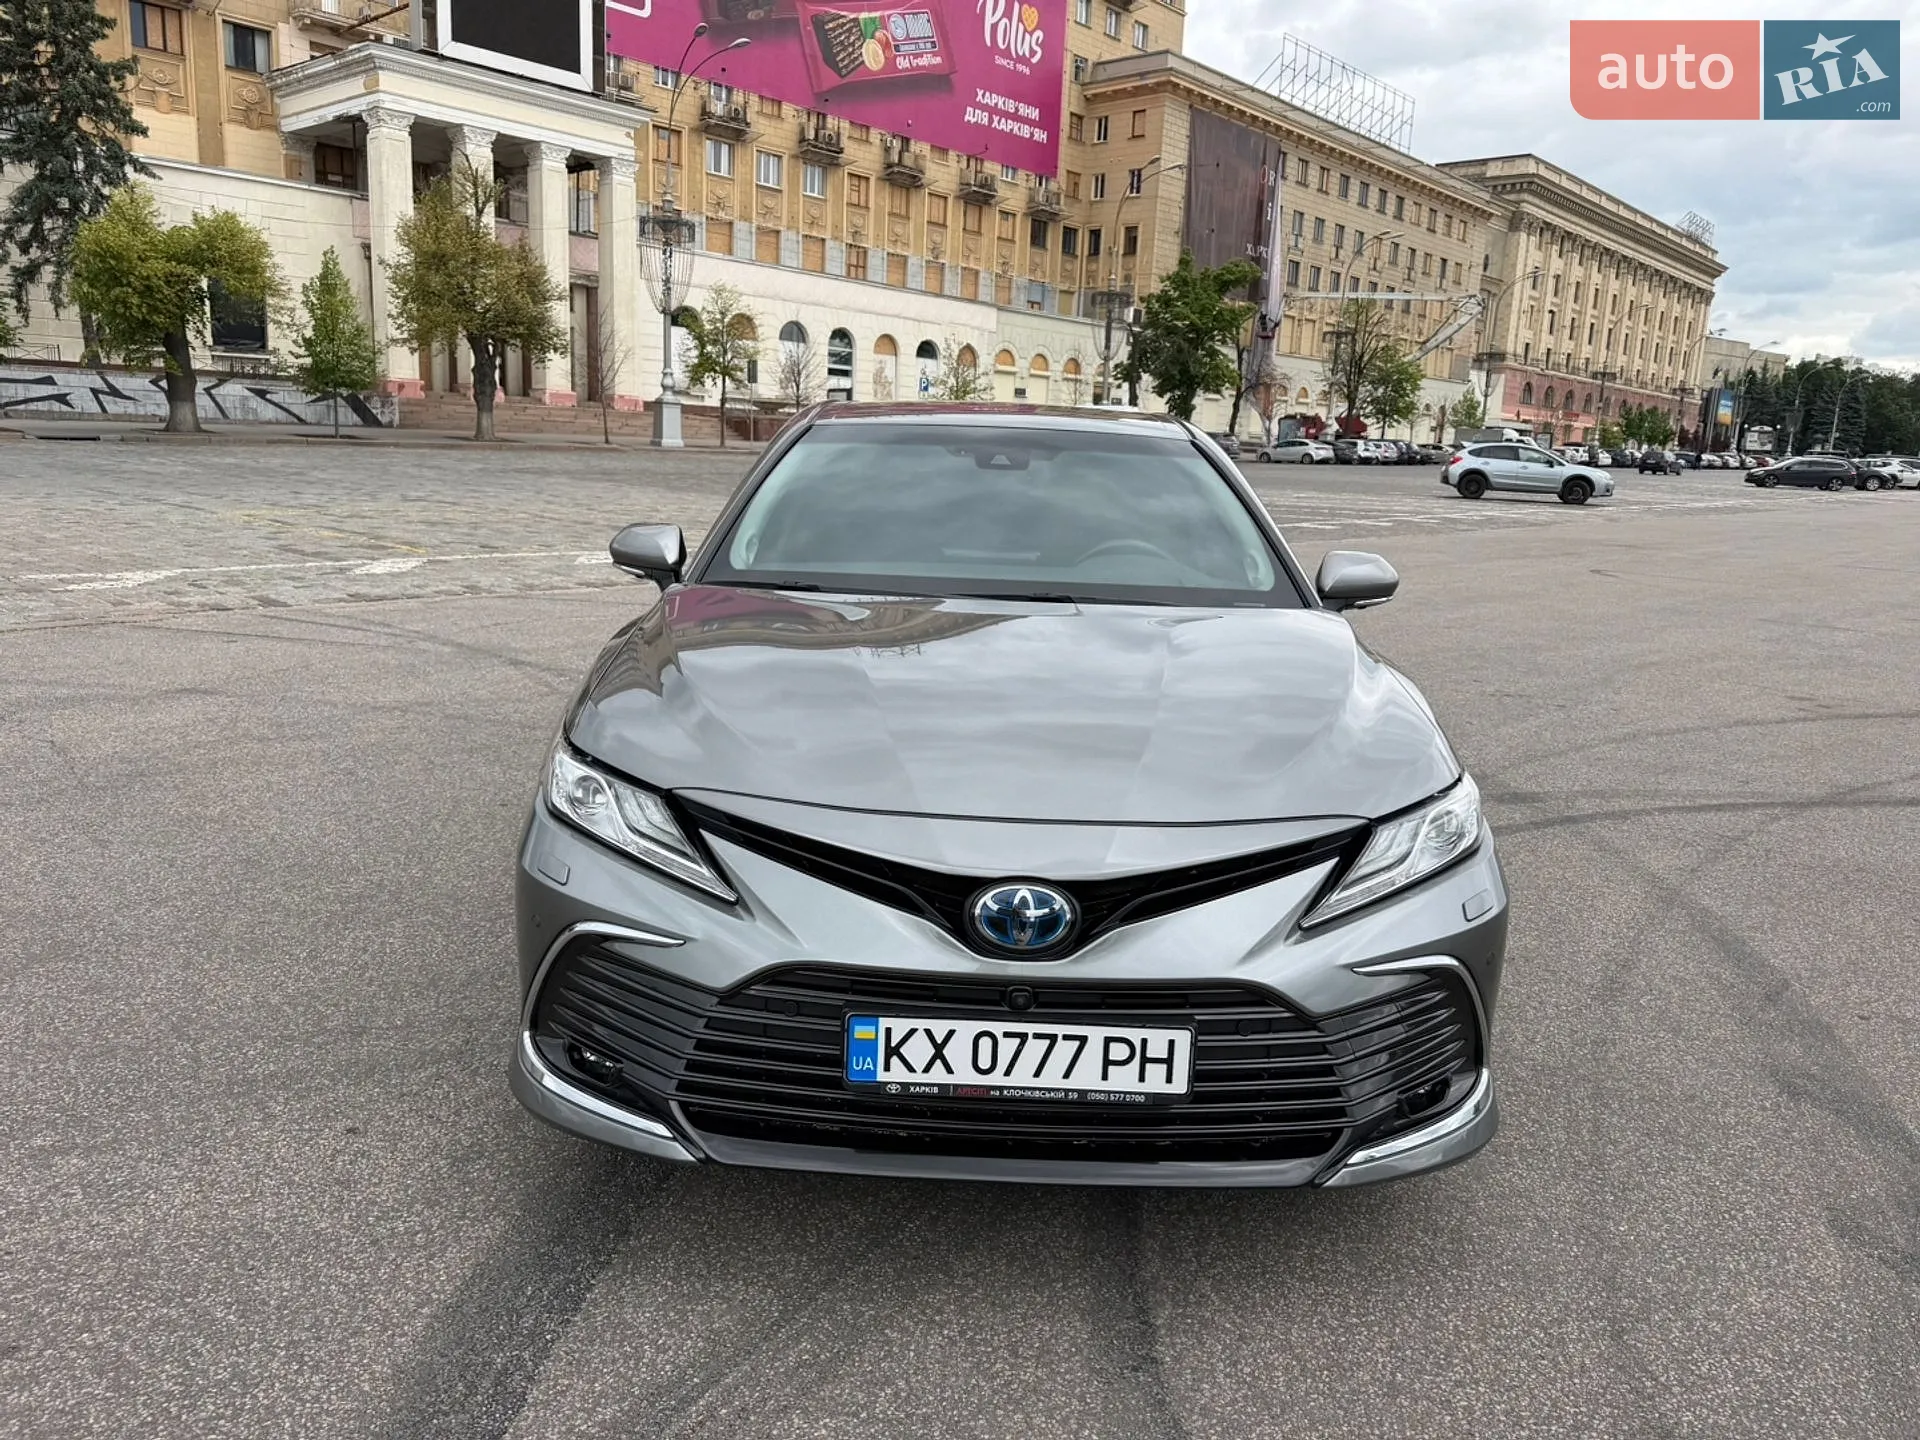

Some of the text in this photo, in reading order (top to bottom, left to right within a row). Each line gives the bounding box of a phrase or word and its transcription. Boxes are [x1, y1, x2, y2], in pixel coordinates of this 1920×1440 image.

[896, 55, 912, 70] Old
[994, 55, 1031, 75] SINCE 1996
[975, 87, 1041, 121] ХАРКІВ'ЯНИ
[964, 106, 1048, 144] ДЛЯ ХАРКІВ'ЯН
[921, 378, 928, 390] P
[853, 1056, 874, 1072] UA
[883, 1027, 1176, 1084] KX 0777 PH
[909, 1085, 939, 1094] ХАРКІВ
